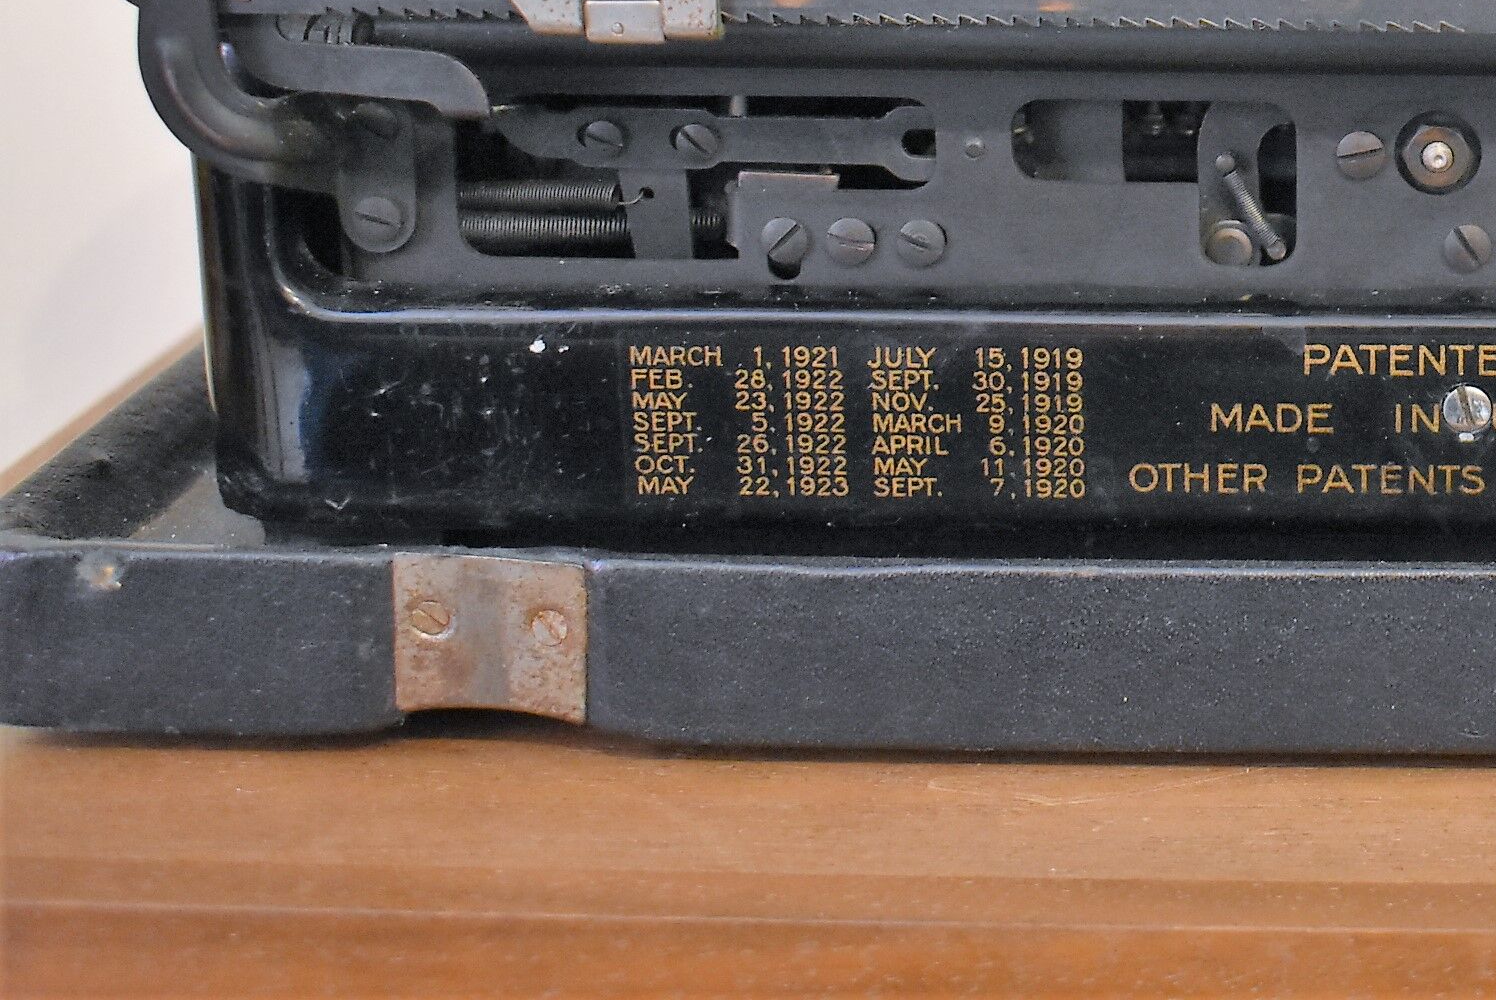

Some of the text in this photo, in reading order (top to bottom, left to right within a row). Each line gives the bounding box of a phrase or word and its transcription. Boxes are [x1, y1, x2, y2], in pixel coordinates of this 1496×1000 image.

[628, 346, 722, 367] MARCH
[782, 346, 838, 367] 1921
[867, 347, 937, 369] JULY
[1021, 347, 1083, 370] 1919
[630, 369, 693, 390] FEB.
[782, 370, 844, 390] 1922
[870, 370, 939, 391] SEPT.
[1022, 371, 1083, 392] 1919
[631, 392, 687, 410] MAY
[784, 392, 845, 412] 1922
[871, 392, 933, 412] NOV.
[1023, 393, 1083, 413] 1919
[633, 412, 702, 432] SEPT.
[784, 413, 845, 433] 1922
[872, 413, 962, 434] MARCH
[1022, 414, 1085, 434] 1920
[1209, 403, 1334, 432] MADE
[1394, 403, 1441, 432] IN
[634, 433, 703, 454] SEPT.
[786, 434, 847, 455] 1922
[872, 436, 949, 455] APRIL
[1023, 436, 1085, 457] 1920
[635, 455, 695, 474] OCT.
[786, 456, 847, 476] 1922
[874, 457, 928, 476] MAY
[1023, 458, 1085, 478] 1920
[637, 476, 694, 495] MAY
[787, 477, 849, 497] 1923
[874, 478, 943, 497] SEPT.
[1024, 479, 1085, 498] 1920
[1128, 462, 1268, 494] OTHER
[1296, 464, 1486, 495] PATENTS
